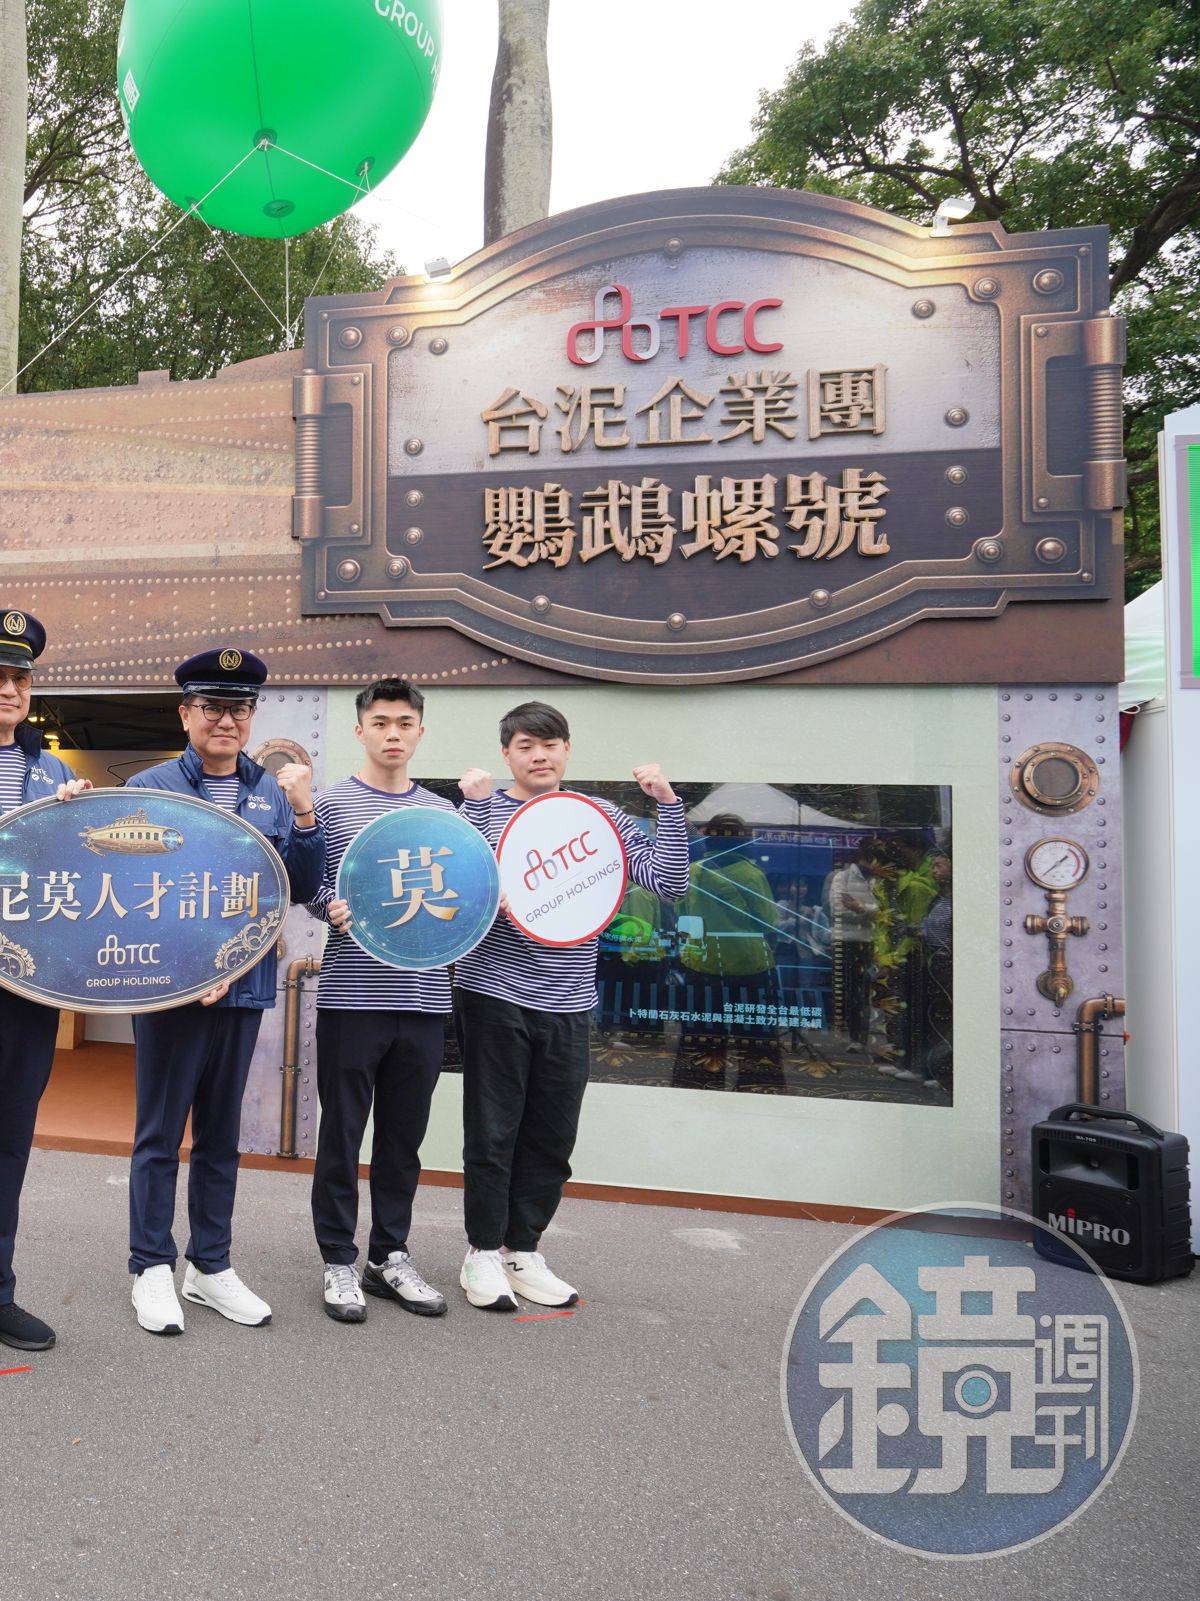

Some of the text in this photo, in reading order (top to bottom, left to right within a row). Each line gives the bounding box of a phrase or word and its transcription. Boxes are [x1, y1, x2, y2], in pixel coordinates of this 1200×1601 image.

[374, 0, 435, 57] GROUP
[658, 297, 785, 359] TCC
[480, 362, 890, 458] 台泥企業團
[481, 467, 892, 571] 鸚鵡螺號
[552, 830, 598, 871] TCC
[377, 846, 460, 929] 莫
[525, 859, 622, 924] GROUP HOLDINGS
[86, 976, 171, 988] GROUP HOLDINGS
[126, 943, 160, 965] TCC
[723, 1002, 822, 1017] 台泥研發全台最低碳
